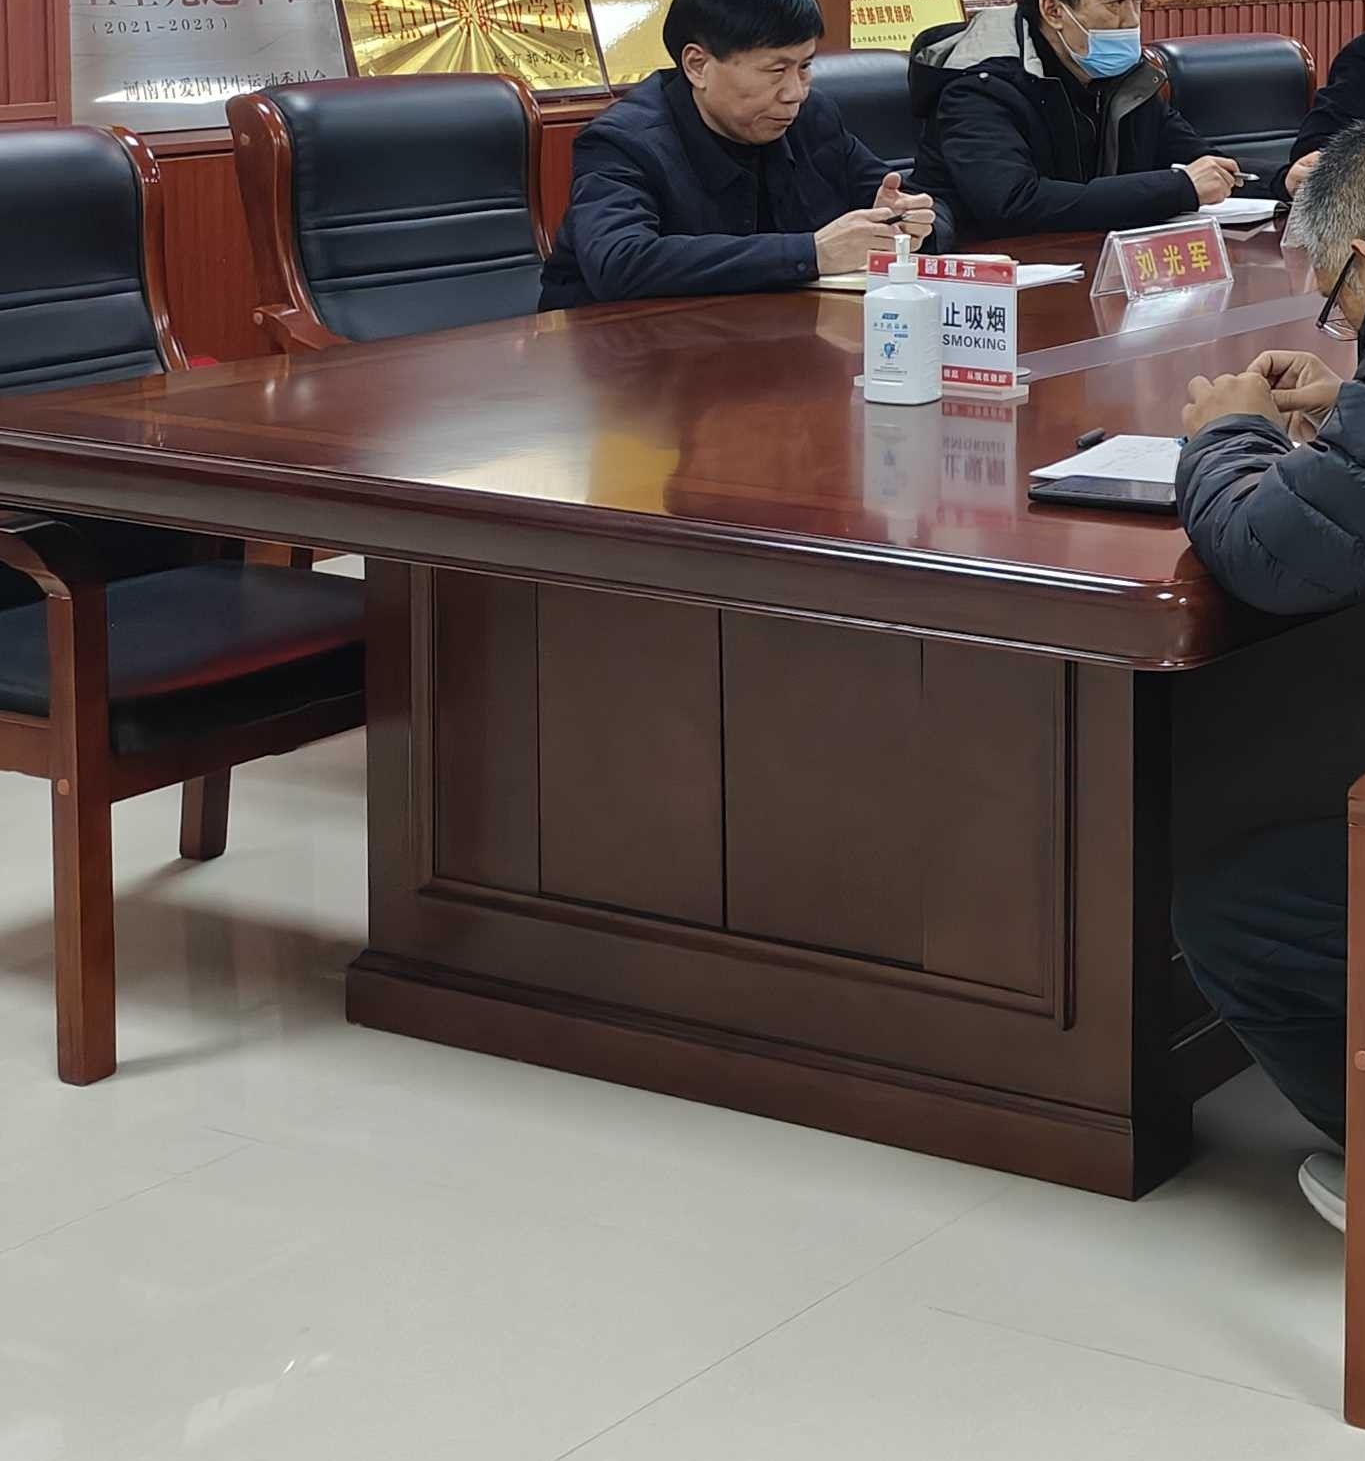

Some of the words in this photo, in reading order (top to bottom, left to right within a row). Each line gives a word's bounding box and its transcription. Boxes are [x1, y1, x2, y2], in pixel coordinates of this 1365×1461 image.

[494, 47, 587, 69] 教育部办公厅
[908, 257, 977, 278] 馨提示
[1134, 240, 1211, 281] 刘光军
[942, 301, 1007, 334] 止吸烟
[942, 334, 1007, 352] SMOKING
